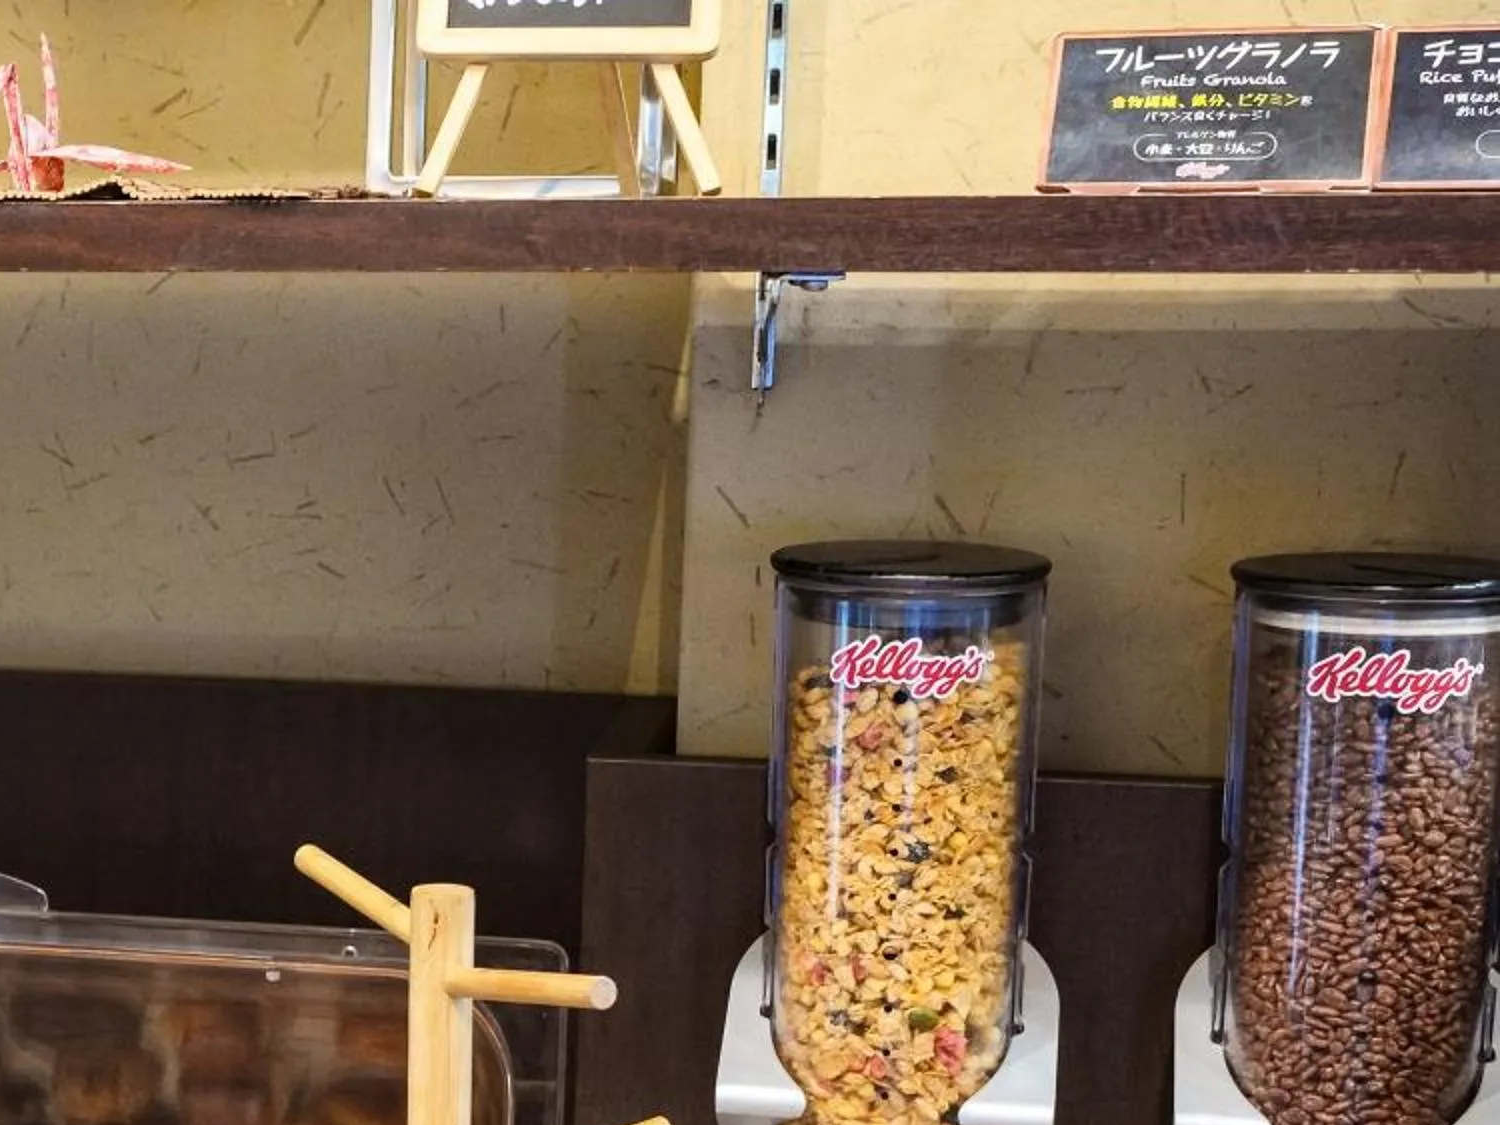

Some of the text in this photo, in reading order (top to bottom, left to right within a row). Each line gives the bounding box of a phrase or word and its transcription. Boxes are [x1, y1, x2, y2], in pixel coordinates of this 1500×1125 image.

[1096, 41, 1341, 74] フルーツグラノラ
[1141, 73, 1288, 88] Fruits Granola
[1419, 71, 1463, 84] Rice
[833, 637, 990, 698] Kellogg's
[1310, 650, 1478, 712] Kellogg's
